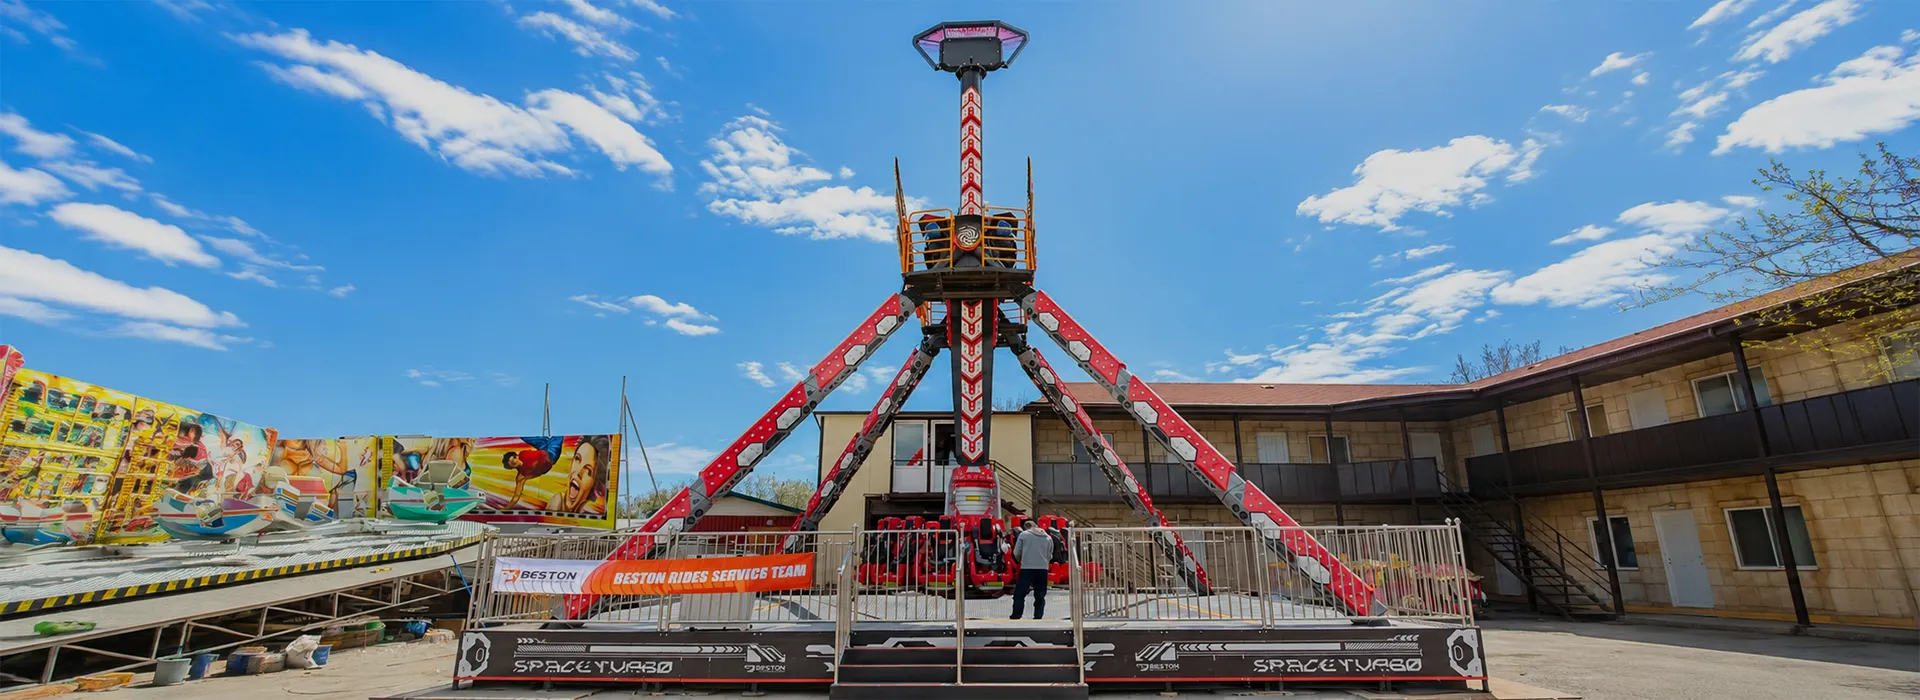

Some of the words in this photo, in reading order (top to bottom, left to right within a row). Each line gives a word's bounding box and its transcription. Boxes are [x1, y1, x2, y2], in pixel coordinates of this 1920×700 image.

[520, 570, 577, 580] BESTON
[613, 572, 666, 585] BESTON
[668, 570, 708, 584] RIDES
[712, 567, 768, 582] SERVICE
[772, 564, 807, 578] TEAM
